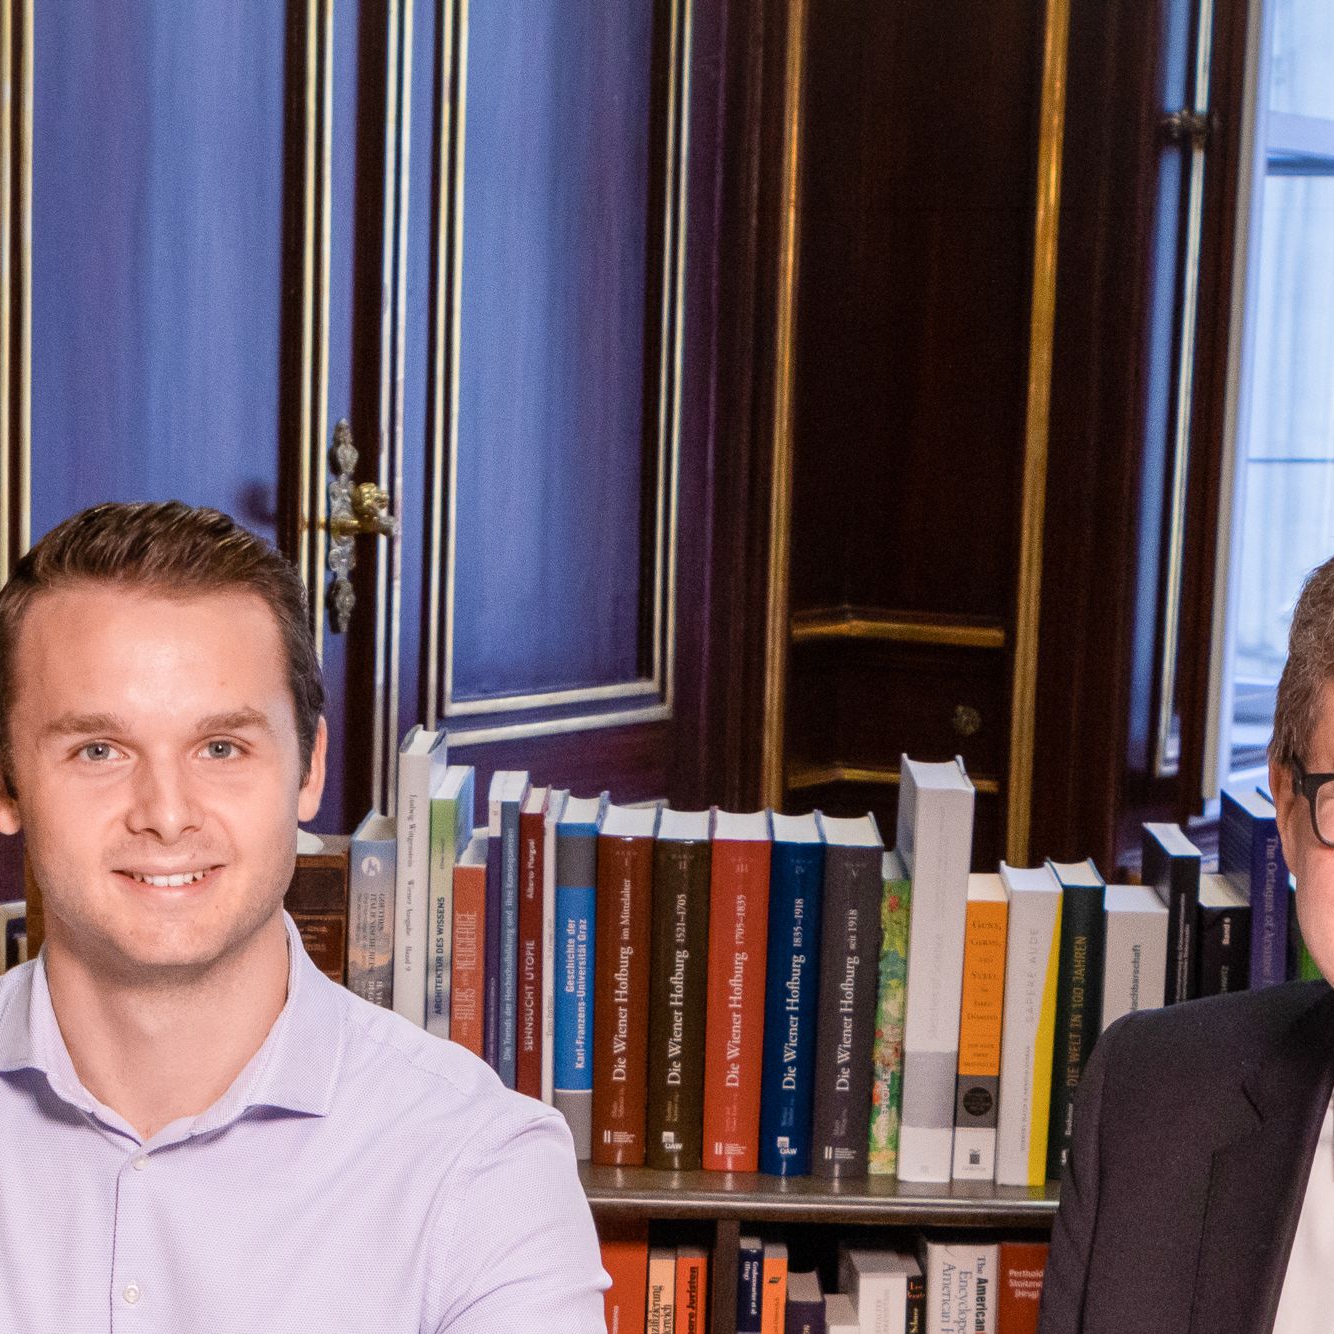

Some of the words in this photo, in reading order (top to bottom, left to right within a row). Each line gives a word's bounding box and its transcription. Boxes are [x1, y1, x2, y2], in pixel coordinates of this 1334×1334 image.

[526, 871, 535, 899] Alberto
[620, 878, 631, 926] Mittelalter
[506, 911, 514, 926] und
[566, 919, 576, 935] der
[577, 919, 587, 941] Graz
[621, 928, 630, 940] im
[847, 909, 859, 932] 1918
[436, 937, 444, 954] DES
[525, 940, 535, 980] UTOPIE
[847, 934, 858, 950] seit
[1027, 927, 1039, 963] AUDE
[1072, 936, 1087, 982] JAHREN
[435, 956, 444, 1015] ARCHITEKTUR
[505, 929, 515, 1001] Hochschulbildung
[565, 938, 576, 992] Geschichte
[614, 946, 633, 1003] Hofburg
[670, 949, 688, 1007] Hofburg
[728, 952, 749, 1008] Hofburg
[785, 954, 806, 1011] Hofburg
[840, 956, 860, 1013] Hofburg
[1131, 944, 1141, 1011] achbarschaft
[524, 984, 535, 1051] SEHNSUCHT
[575, 944, 587, 1069] Karl-Franzens-Universität
[1025, 970, 1038, 1023] SAPERE
[1071, 987, 1083, 1008] 100
[504, 1018, 513, 1044] Trends
[613, 1006, 629, 1055] Wiener
[668, 1010, 684, 1059] Wiener
[727, 1011, 743, 1059] Wiener
[783, 1014, 799, 1062] Wiener
[838, 1016, 853, 1063] Wiener
[1070, 1014, 1082, 1028] IN
[1067, 1031, 1082, 1063] WELT
[612, 1058, 627, 1081] Die
[667, 1061, 681, 1086] Die
[725, 1062, 741, 1087] Die
[782, 1065, 797, 1090] Die
[836, 1067, 851, 1091] Die
[1066, 1066, 1079, 1087] DIE
[976, 1256, 986, 1275] The
[686, 1266, 697, 1310] Juristen
[941, 1262, 956, 1322] American
